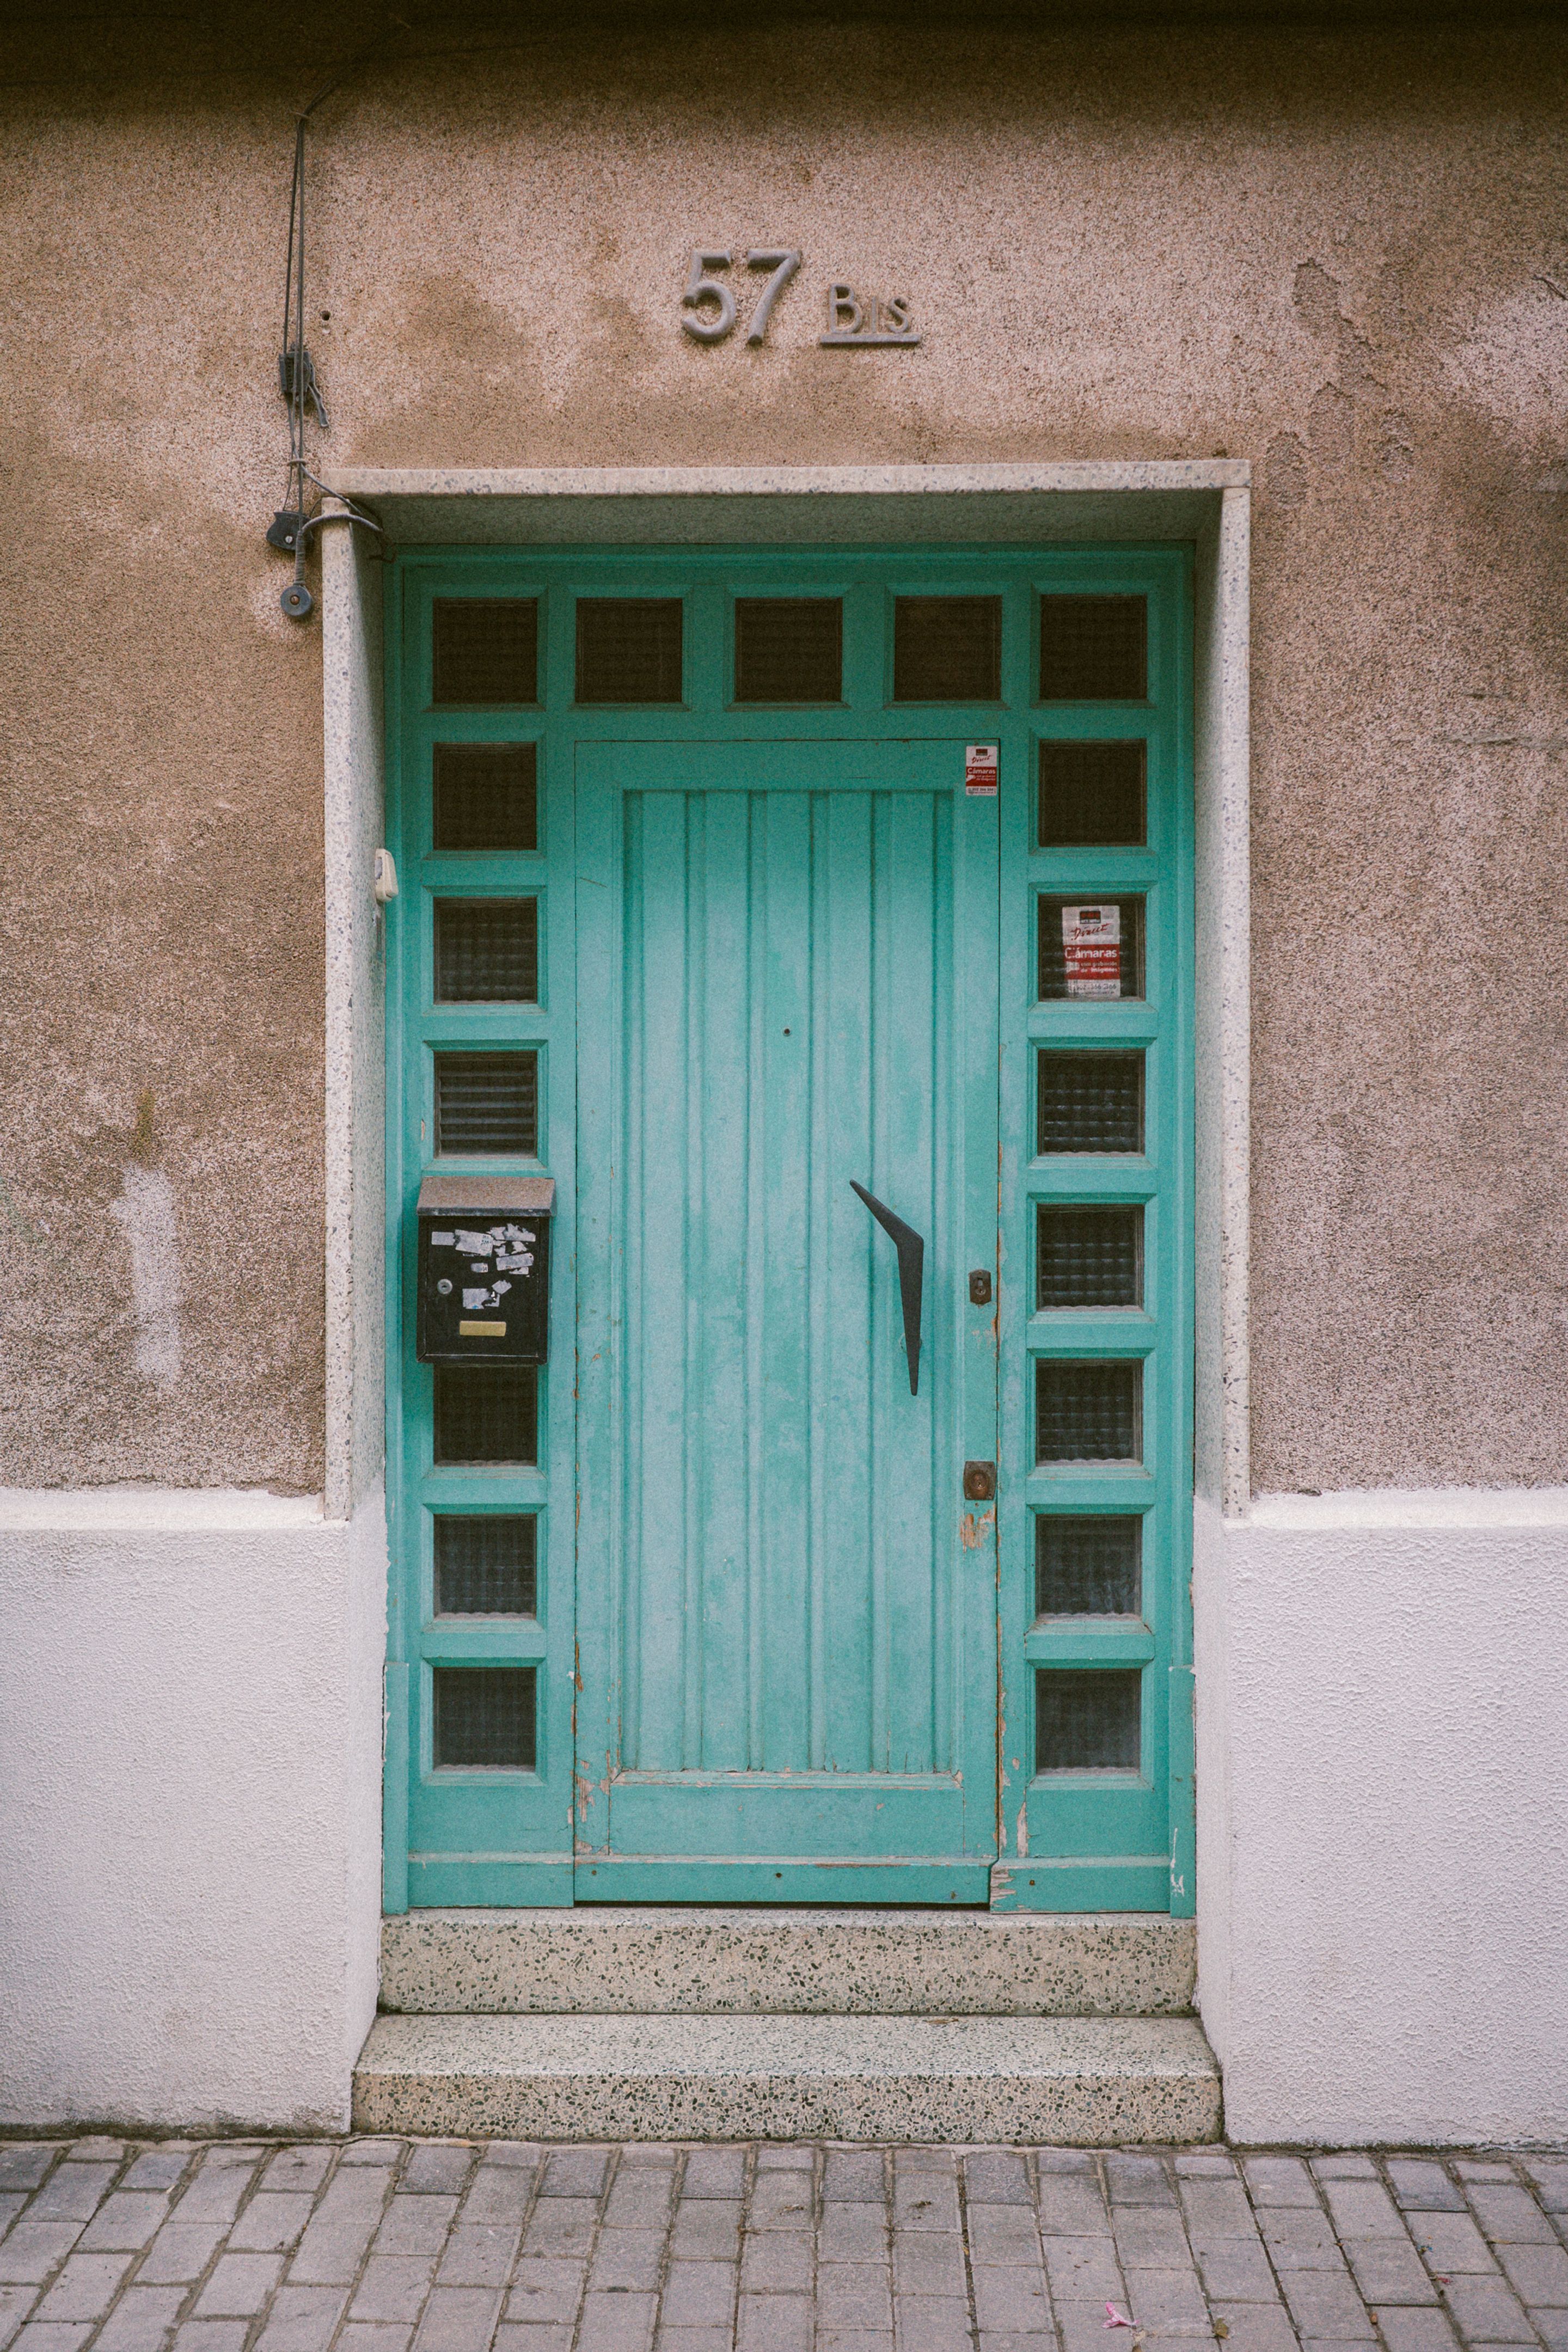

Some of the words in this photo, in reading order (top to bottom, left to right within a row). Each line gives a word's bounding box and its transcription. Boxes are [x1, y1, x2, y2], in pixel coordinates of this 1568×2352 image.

[682, 248, 803, 345] 57
[1070, 923, 1112, 940] Direct
[1064, 947, 1117, 959] Cámaras
